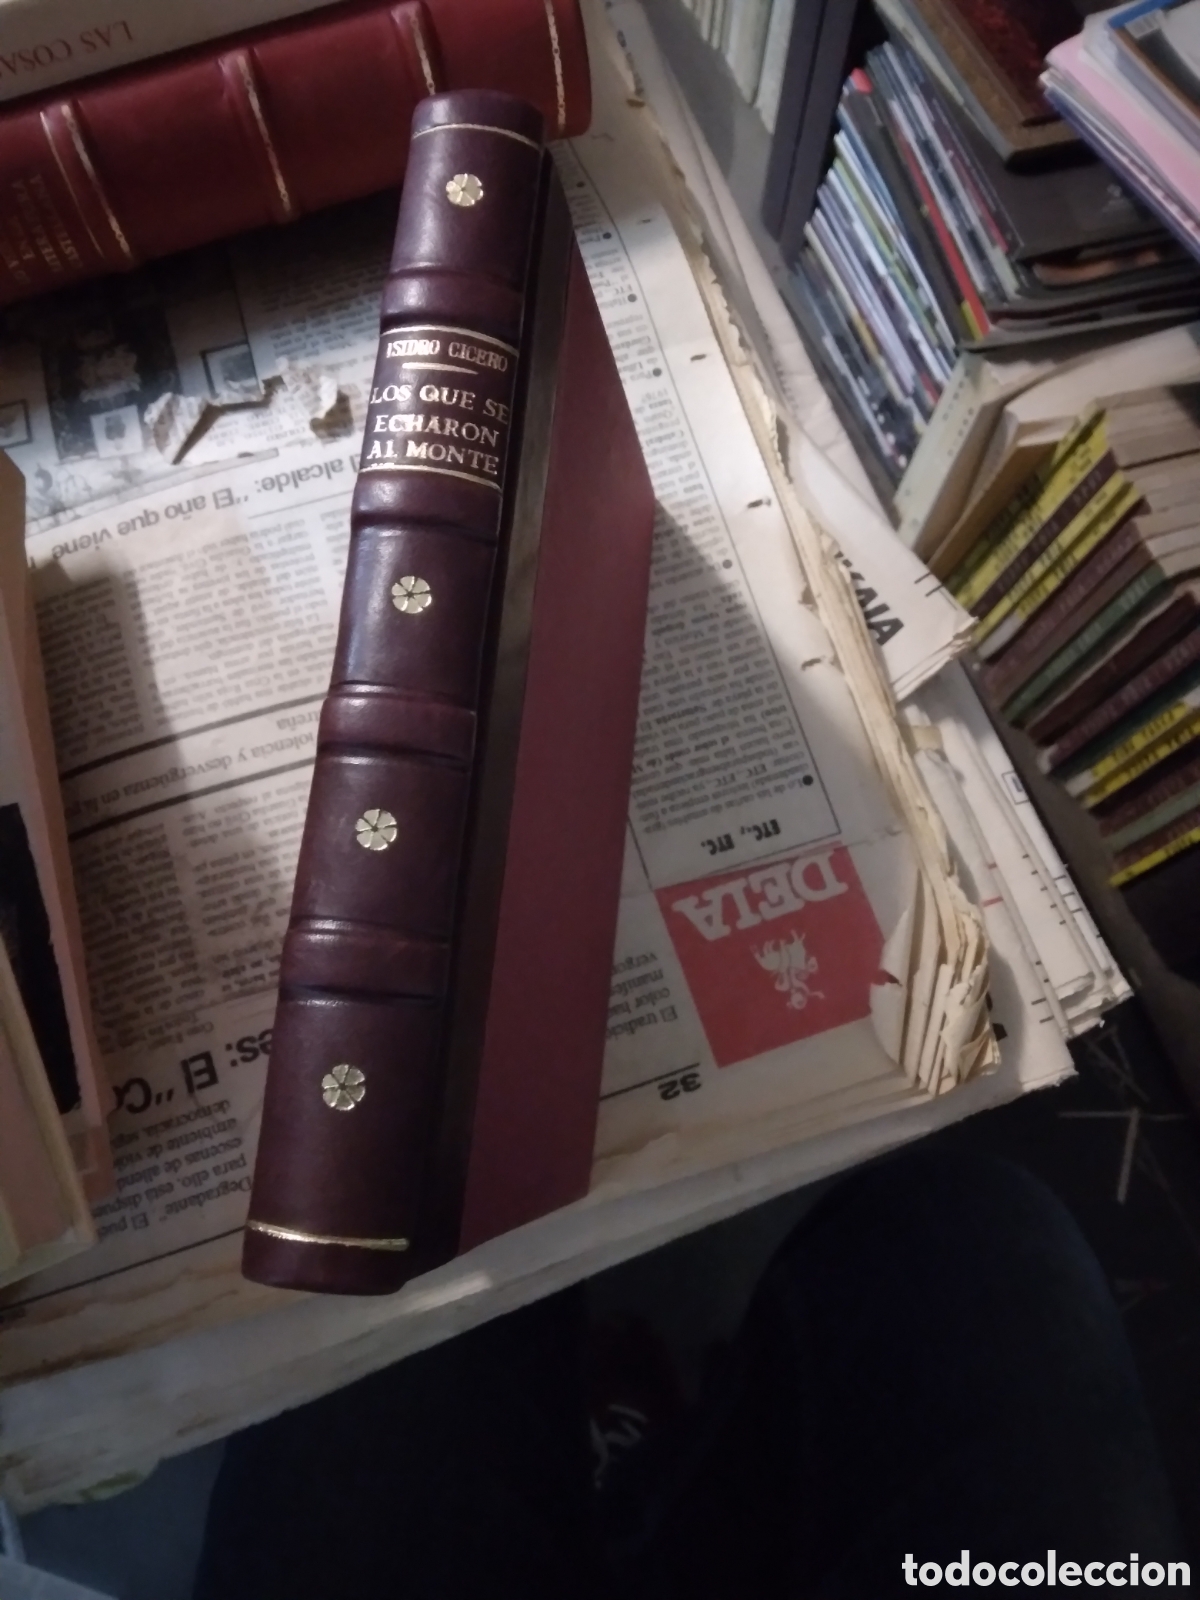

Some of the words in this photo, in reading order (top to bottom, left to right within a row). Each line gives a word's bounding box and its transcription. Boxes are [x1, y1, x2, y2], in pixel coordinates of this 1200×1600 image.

[78, 20, 132, 53] LAS
[0, 38, 72, 78] COSA
[386, 339, 440, 358] ISIDRO
[448, 341, 508, 372] CICERO
[370, 384, 412, 404] LOS
[419, 384, 476, 410] QUE
[483, 398, 509, 425] SE
[374, 413, 499, 447] ECHARON
[367, 439, 398, 459] AL
[405, 440, 498, 475] MONTE
[255, 459, 343, 493] alcalde:
[115, 508, 160, 538] que
[163, 495, 208, 523] año
[699, 833, 734, 856] ETC.
[739, 817, 780, 844] ETC.,
[672, 849, 849, 941] DEIA
[659, 1006, 677, 1022] El
[178, 1052, 219, 1094] El
[657, 1072, 702, 1101] 32
[145, 1143, 164, 1159] de
[211, 1154, 246, 1176] para
[130, 1212, 149, 1229] El
